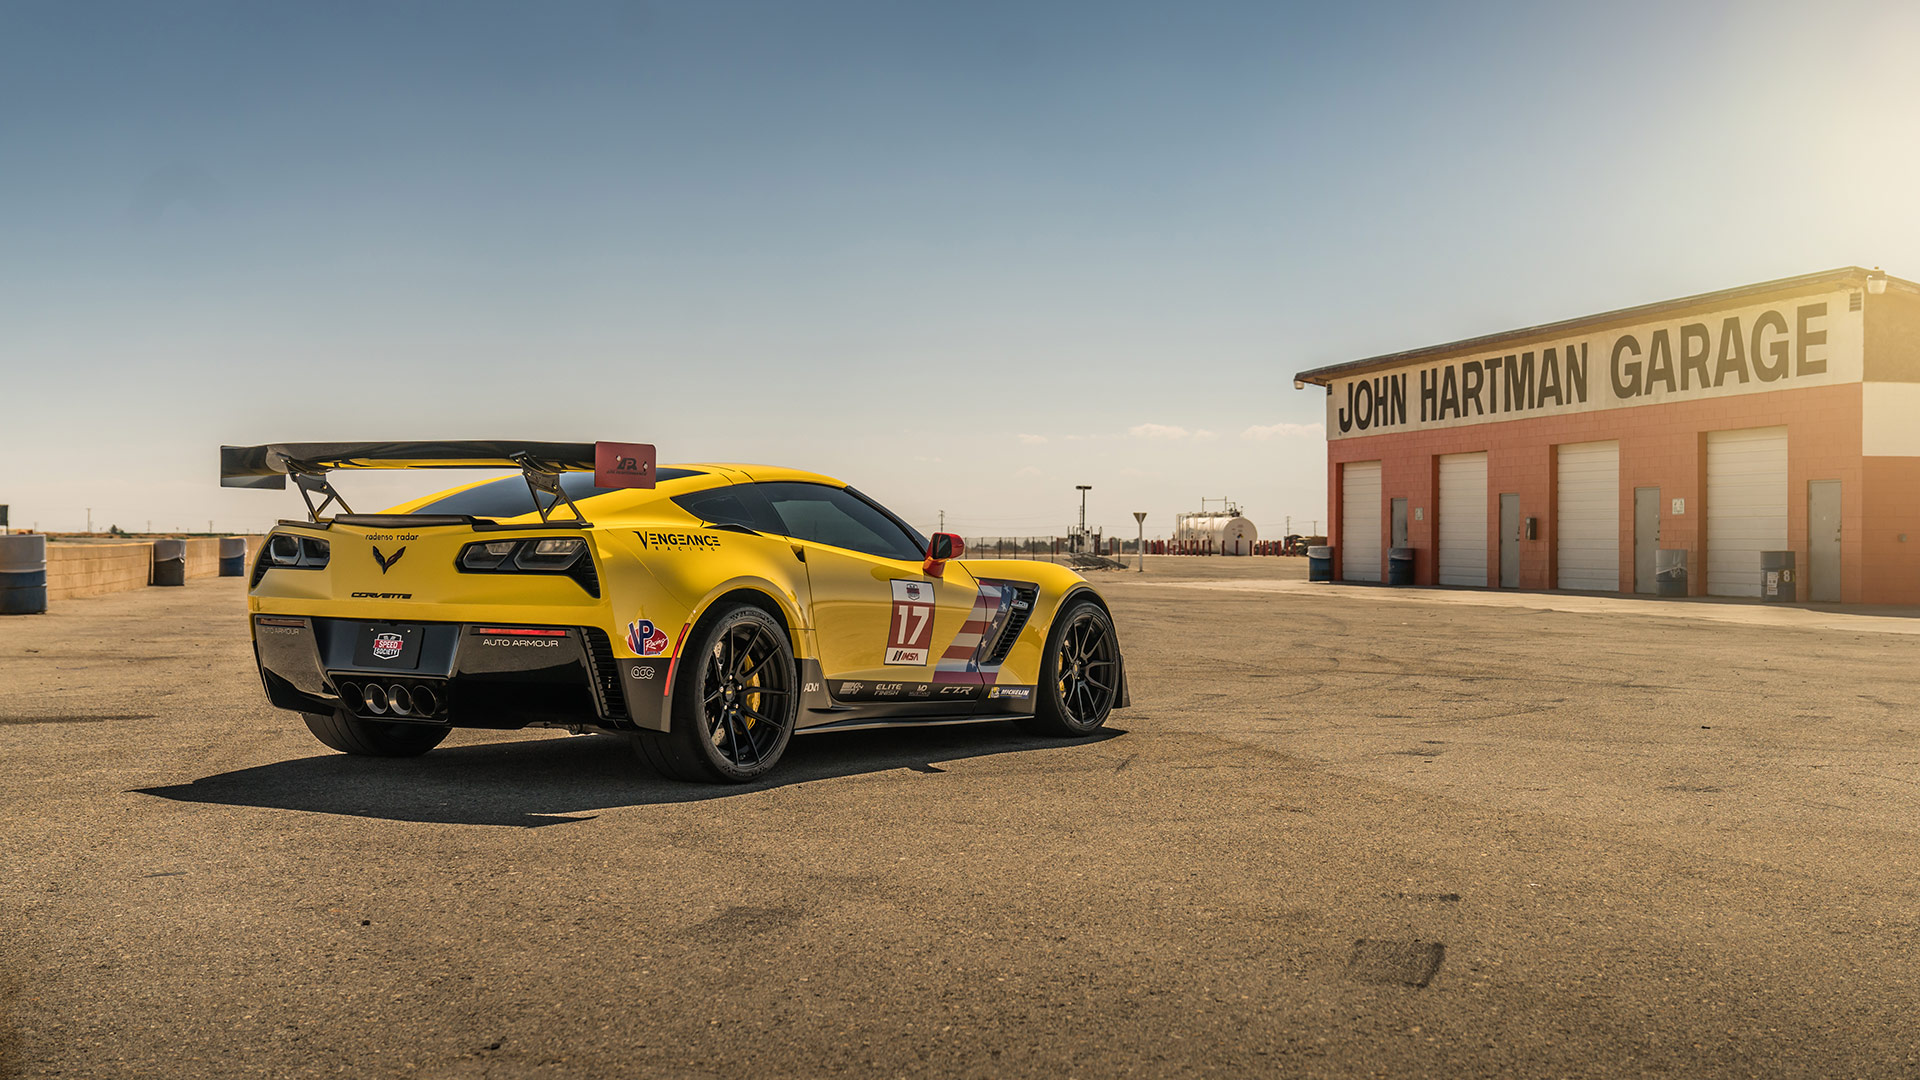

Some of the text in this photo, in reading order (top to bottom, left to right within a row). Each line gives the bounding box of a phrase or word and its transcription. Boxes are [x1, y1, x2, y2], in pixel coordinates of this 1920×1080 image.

[1338, 302, 1828, 433] JOHN HARTMAN GARAGE
[365, 532, 419, 541] radenso radar
[632, 530, 721, 551] VENGEANCE
[1783, 570, 1790, 582] 8
[897, 605, 930, 645] 17
[379, 640, 399, 649] SPEED
[628, 619, 654, 656] VP
[901, 653, 919, 661] IMSA
